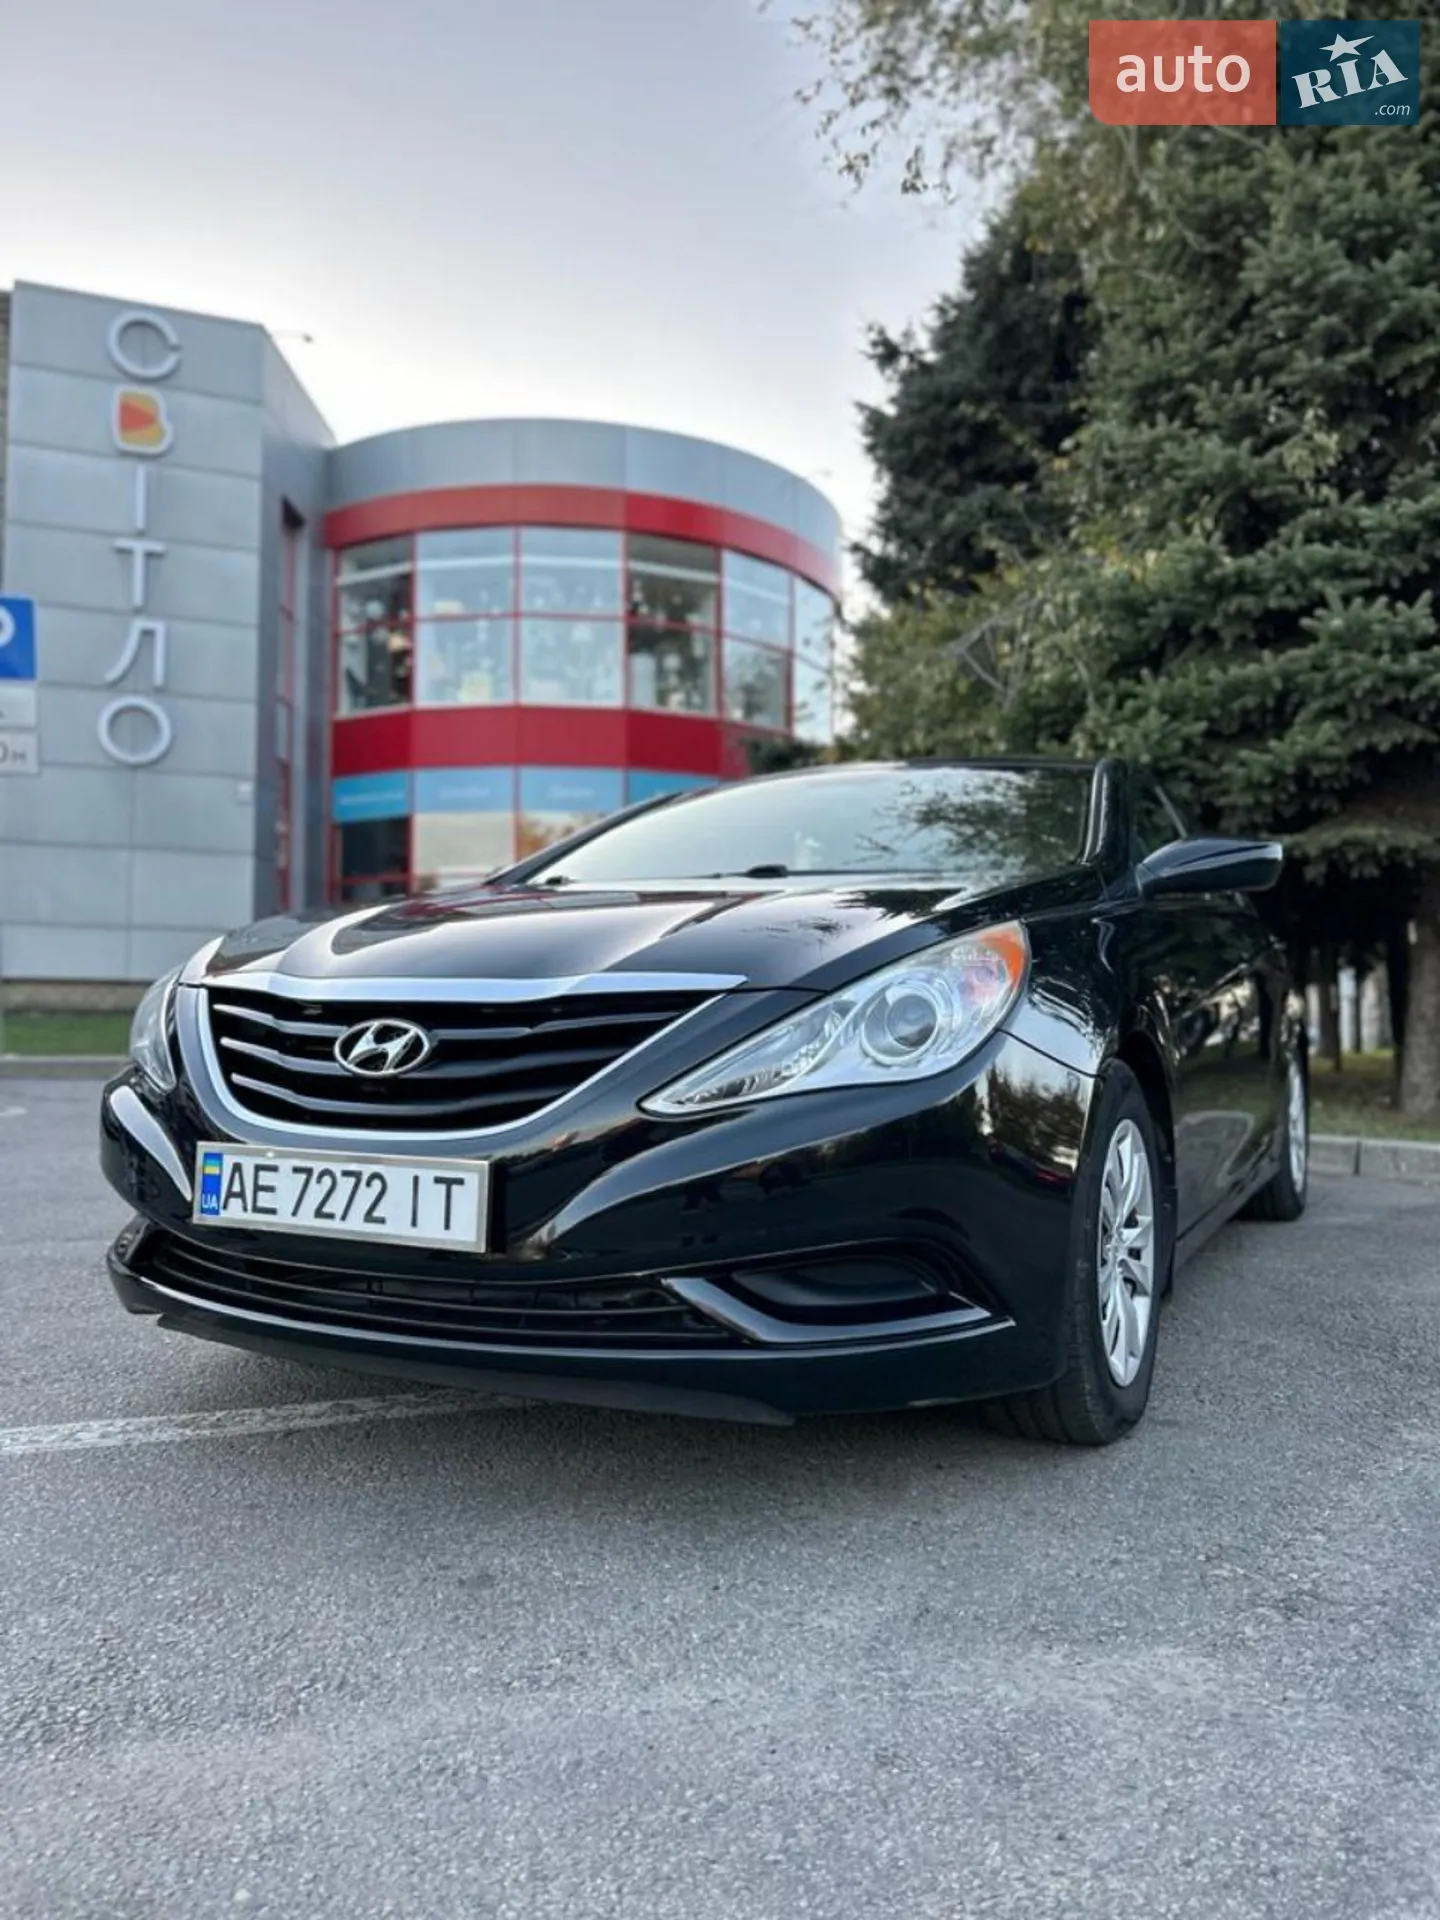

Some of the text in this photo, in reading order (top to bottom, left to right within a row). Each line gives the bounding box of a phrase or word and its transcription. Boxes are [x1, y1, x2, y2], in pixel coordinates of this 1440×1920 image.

[97, 309, 181, 767] СВІТЛО
[201, 1194, 219, 1211] UA
[222, 1162, 465, 1230] AE 7272 IT
